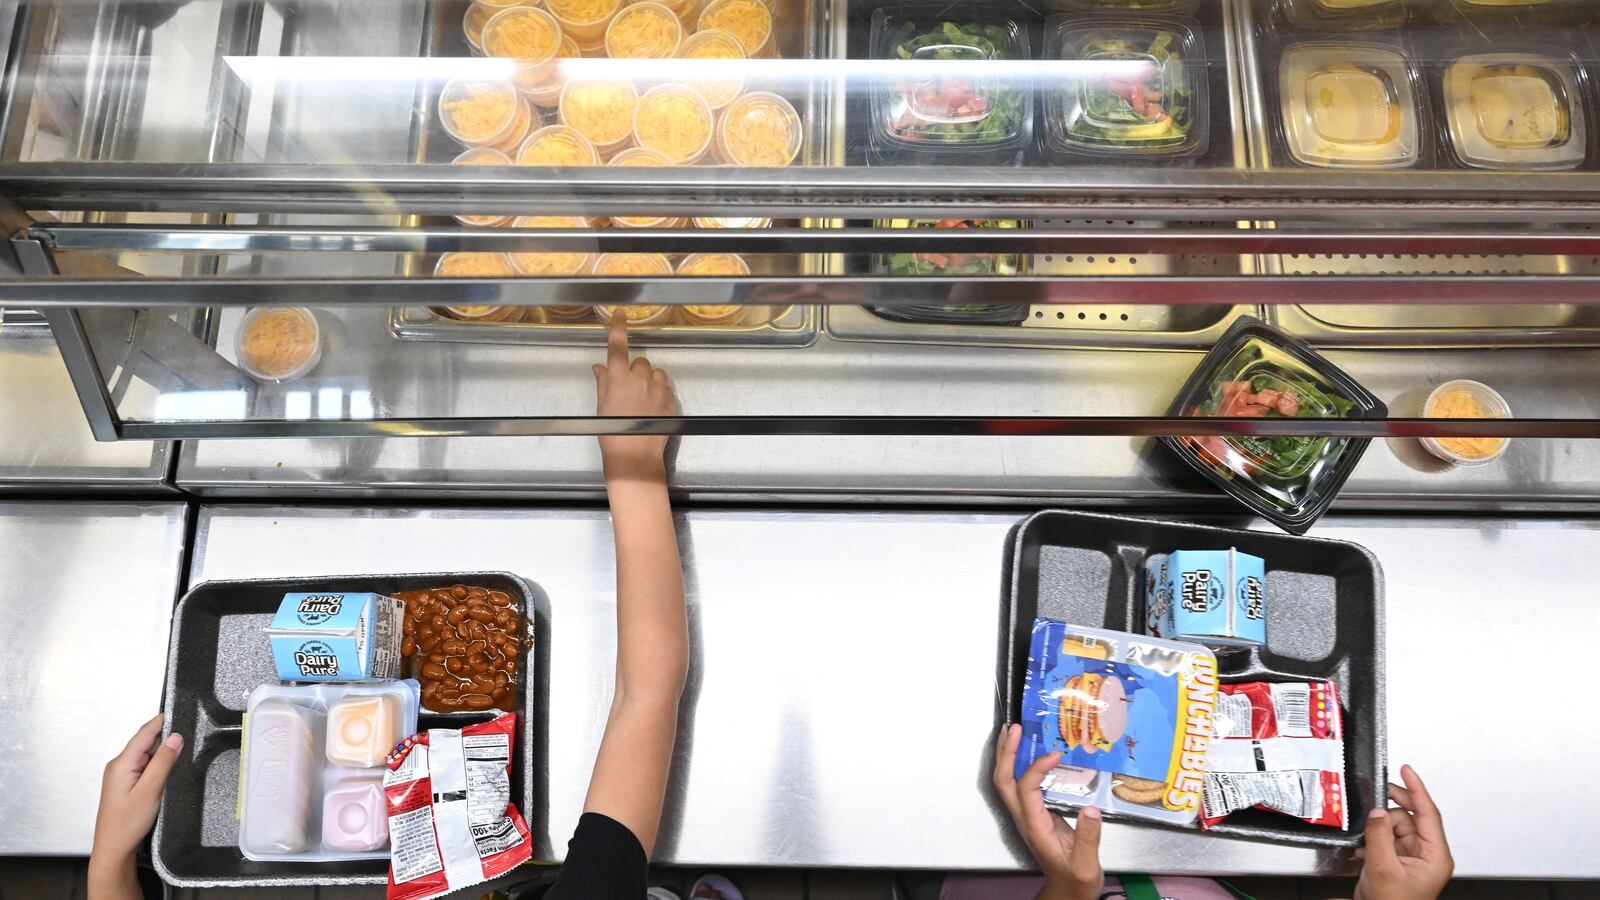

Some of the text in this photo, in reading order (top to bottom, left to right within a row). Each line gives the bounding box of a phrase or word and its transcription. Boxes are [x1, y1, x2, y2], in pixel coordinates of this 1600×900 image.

[1182, 571, 1196, 610] Pure
[1192, 569, 1212, 612] Dairy
[303, 595, 344, 605] Pure
[1246, 576, 1257, 620] Dairy
[297, 602, 342, 616] Dairy
[295, 652, 338, 669] Dairy
[300, 665, 337, 677] Pure
[472, 827, 489, 836] 100
[479, 847, 498, 856] Facts
